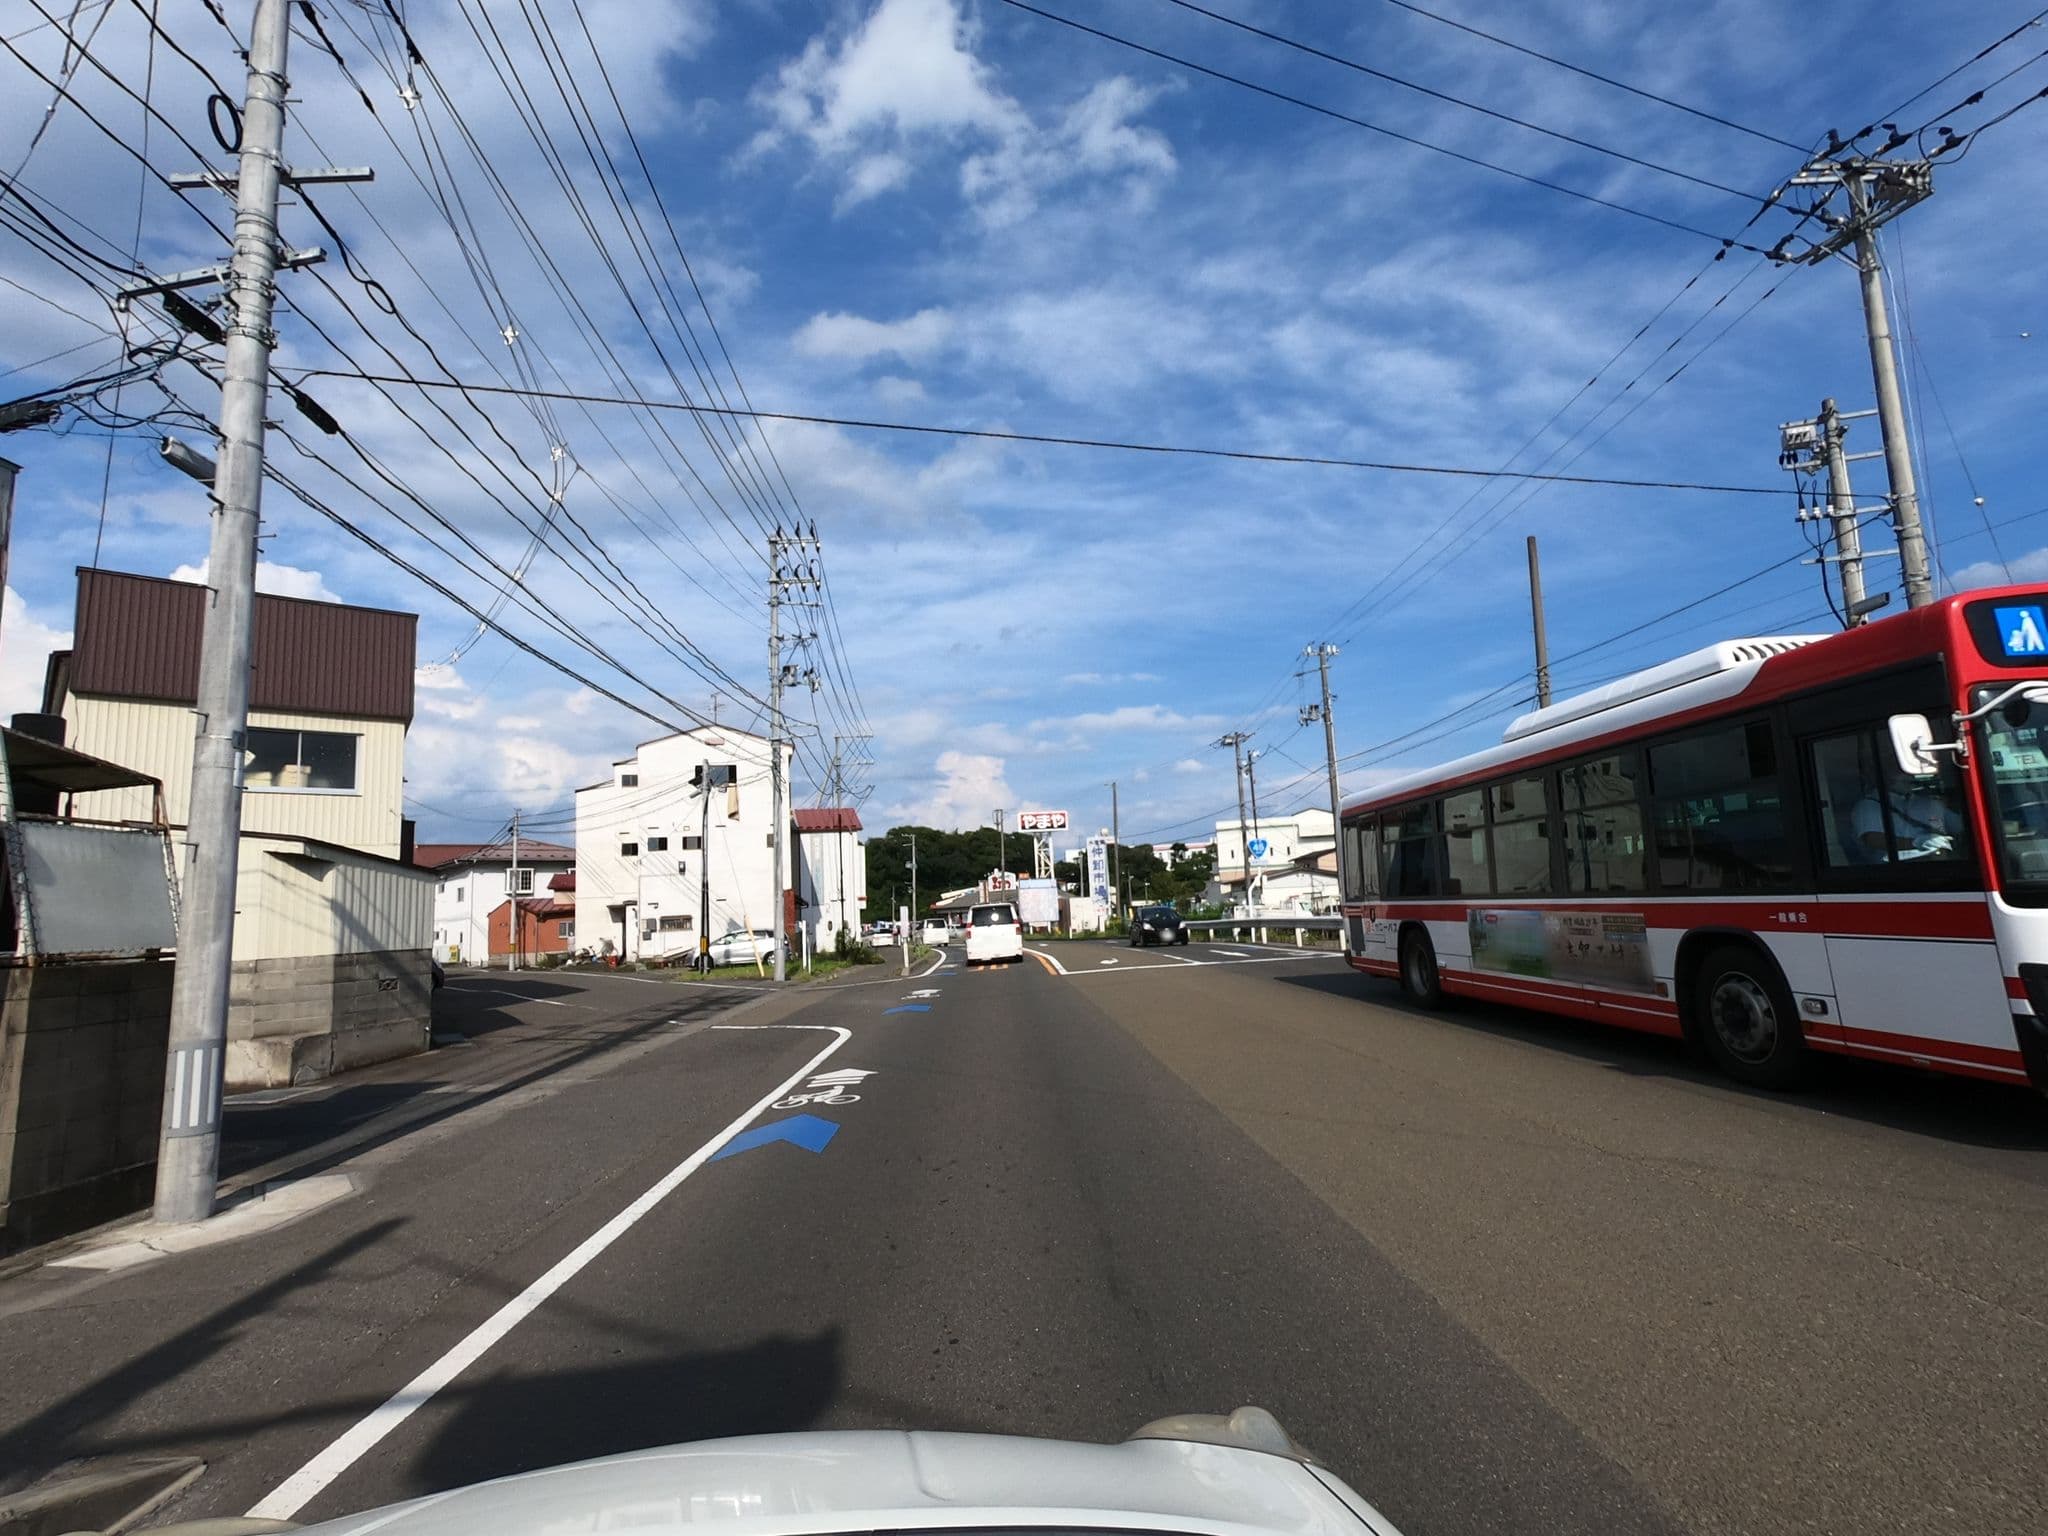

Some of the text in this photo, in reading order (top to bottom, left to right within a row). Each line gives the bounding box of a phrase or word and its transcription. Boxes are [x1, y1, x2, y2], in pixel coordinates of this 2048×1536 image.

[1022, 814, 1065, 829] やまや
[1091, 847, 1107, 899] 仲卸市場
